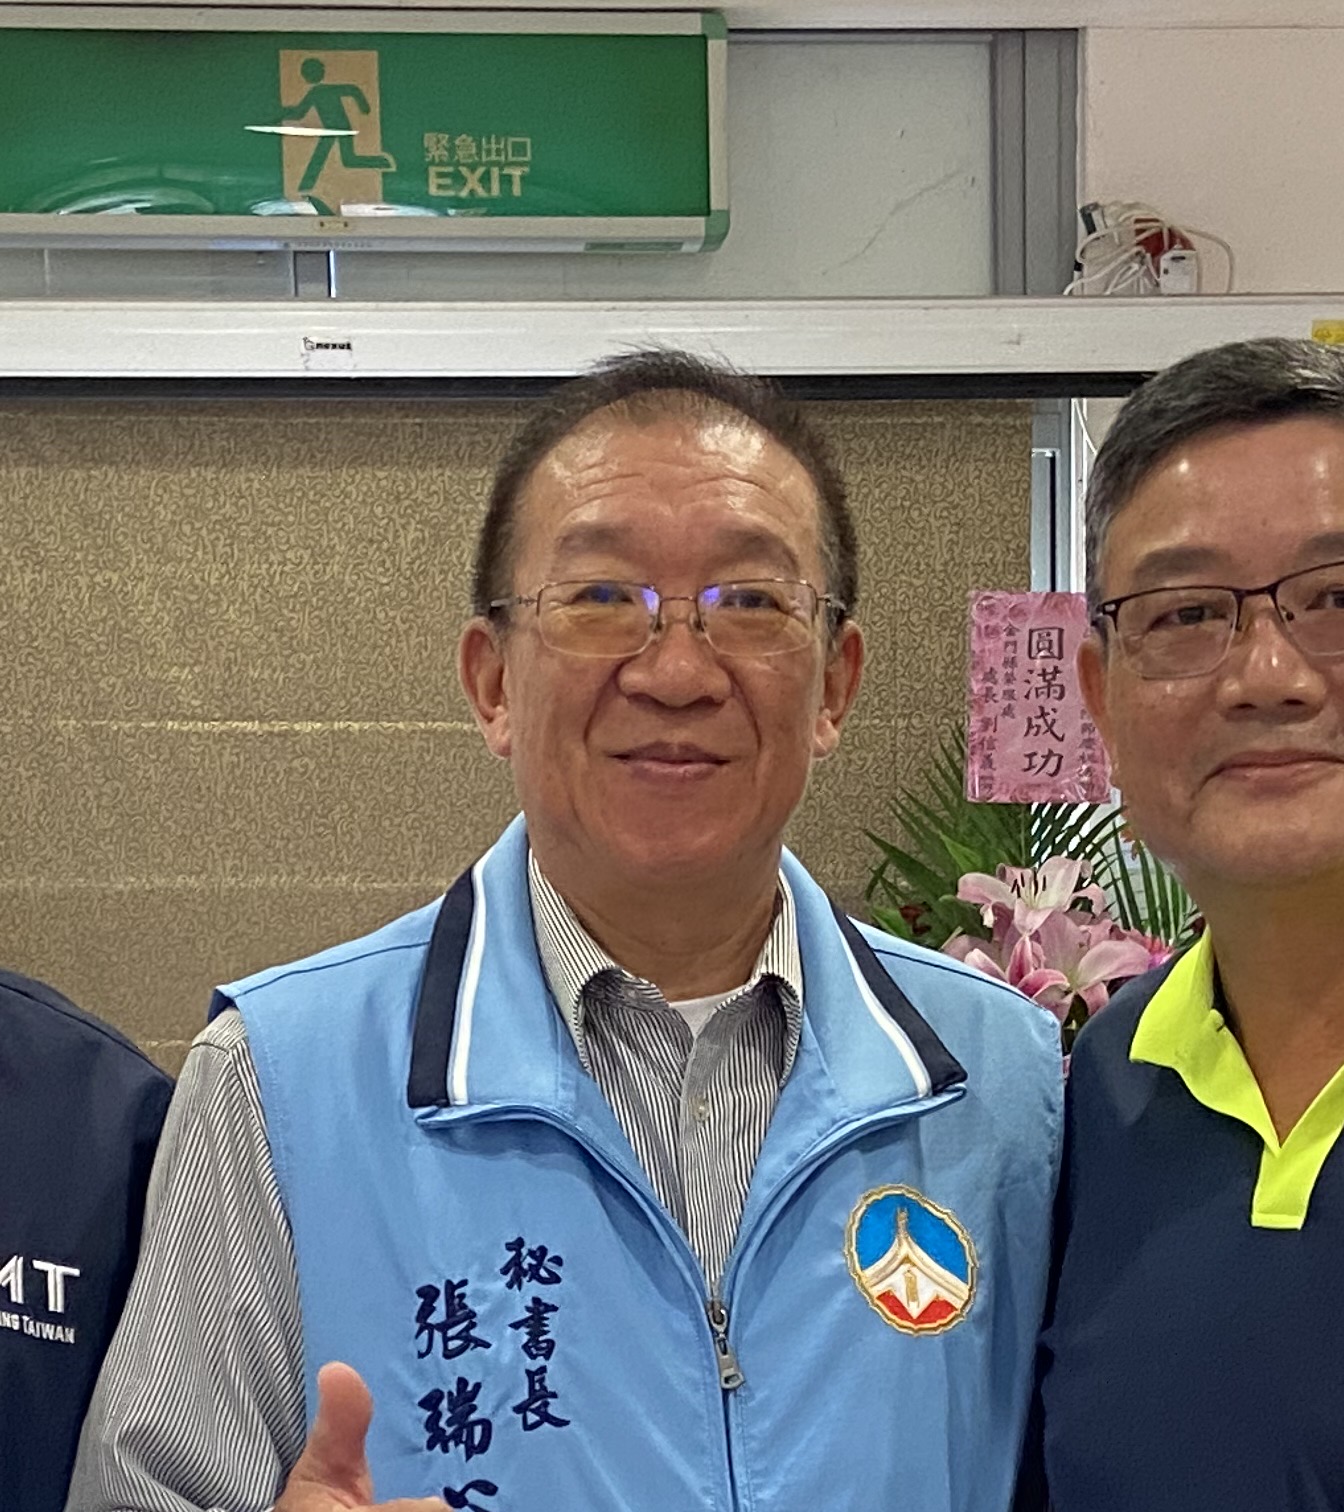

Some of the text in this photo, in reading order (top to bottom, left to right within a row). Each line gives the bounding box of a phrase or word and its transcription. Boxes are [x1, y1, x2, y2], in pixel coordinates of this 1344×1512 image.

[423, 132, 532, 162] 緊急出口
[428, 166, 530, 197] EXIT
[1022, 626, 1067, 778] 圓滿成功
[21, 1316, 75, 1344] TAIWAN
